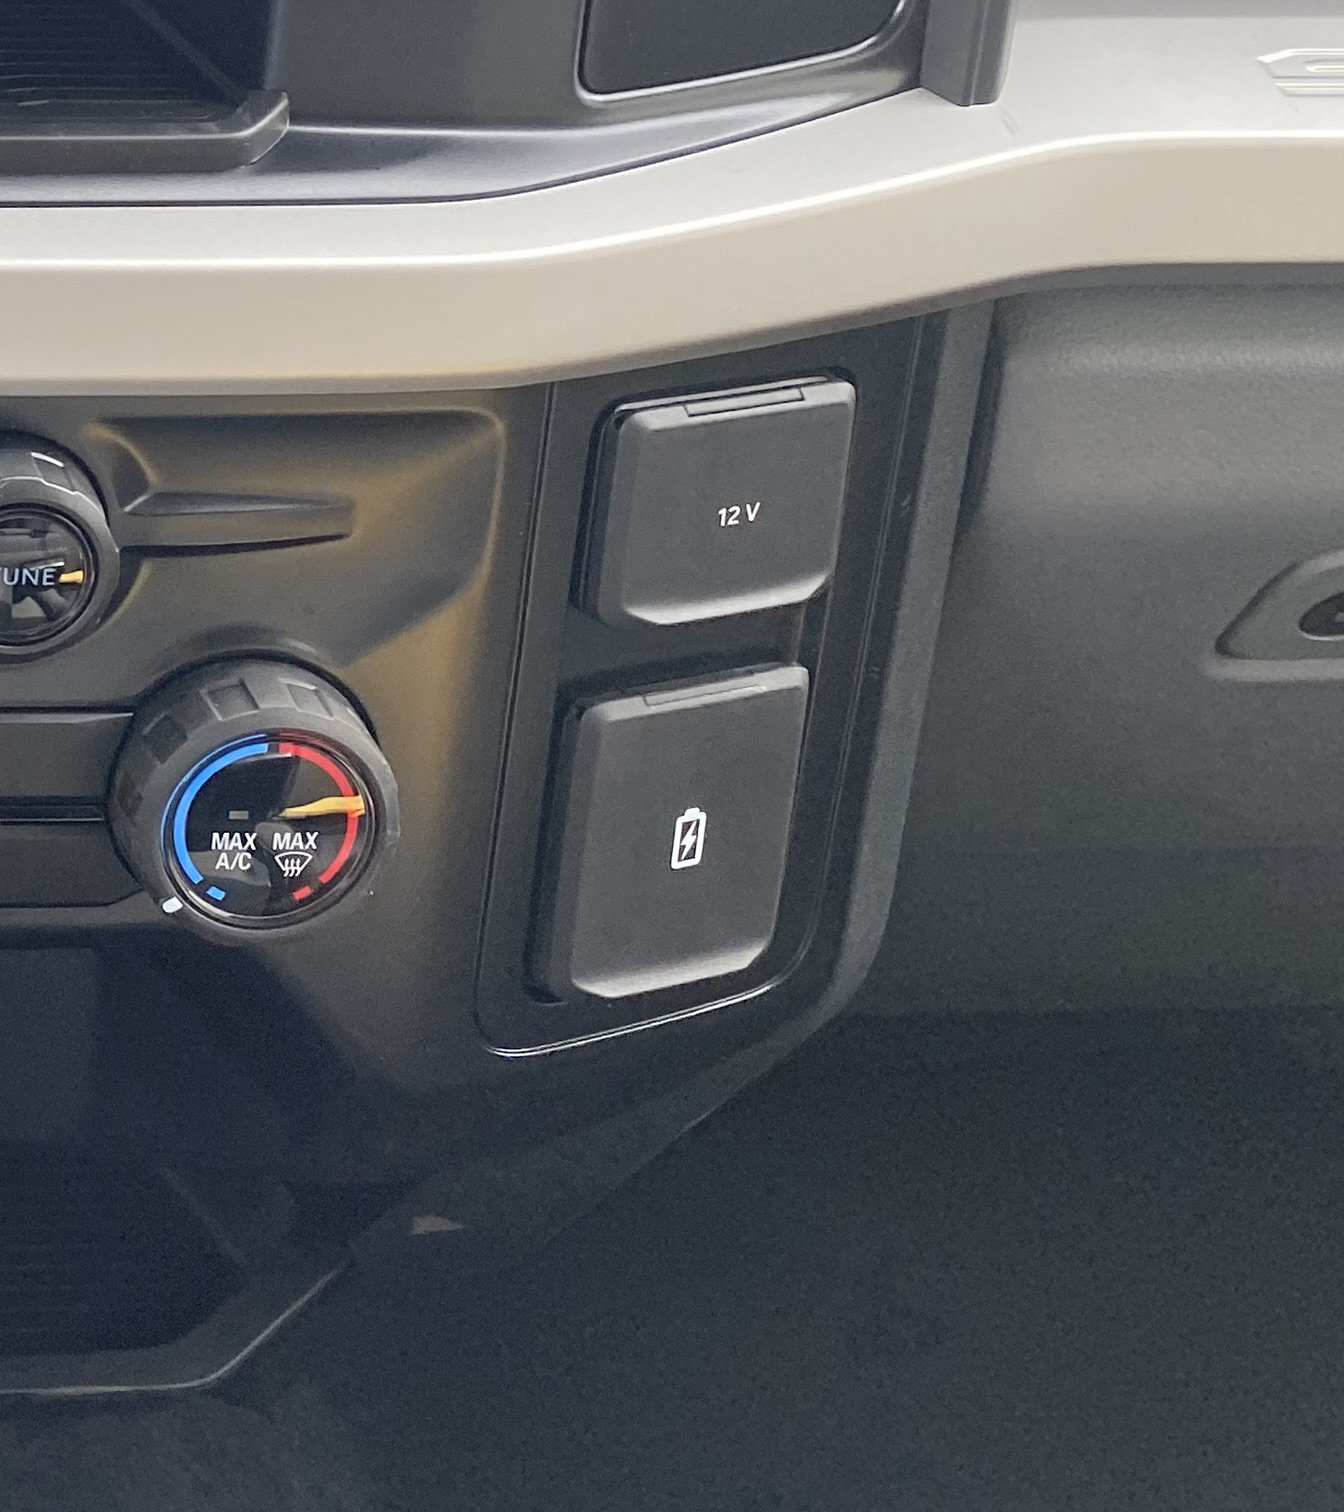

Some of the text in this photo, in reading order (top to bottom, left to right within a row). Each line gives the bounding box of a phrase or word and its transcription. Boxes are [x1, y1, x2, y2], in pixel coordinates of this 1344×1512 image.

[718, 501, 761, 527] 12 V
[211, 832, 257, 851] MAX
[272, 831, 319, 851] MAX
[214, 852, 252, 871] A/C
